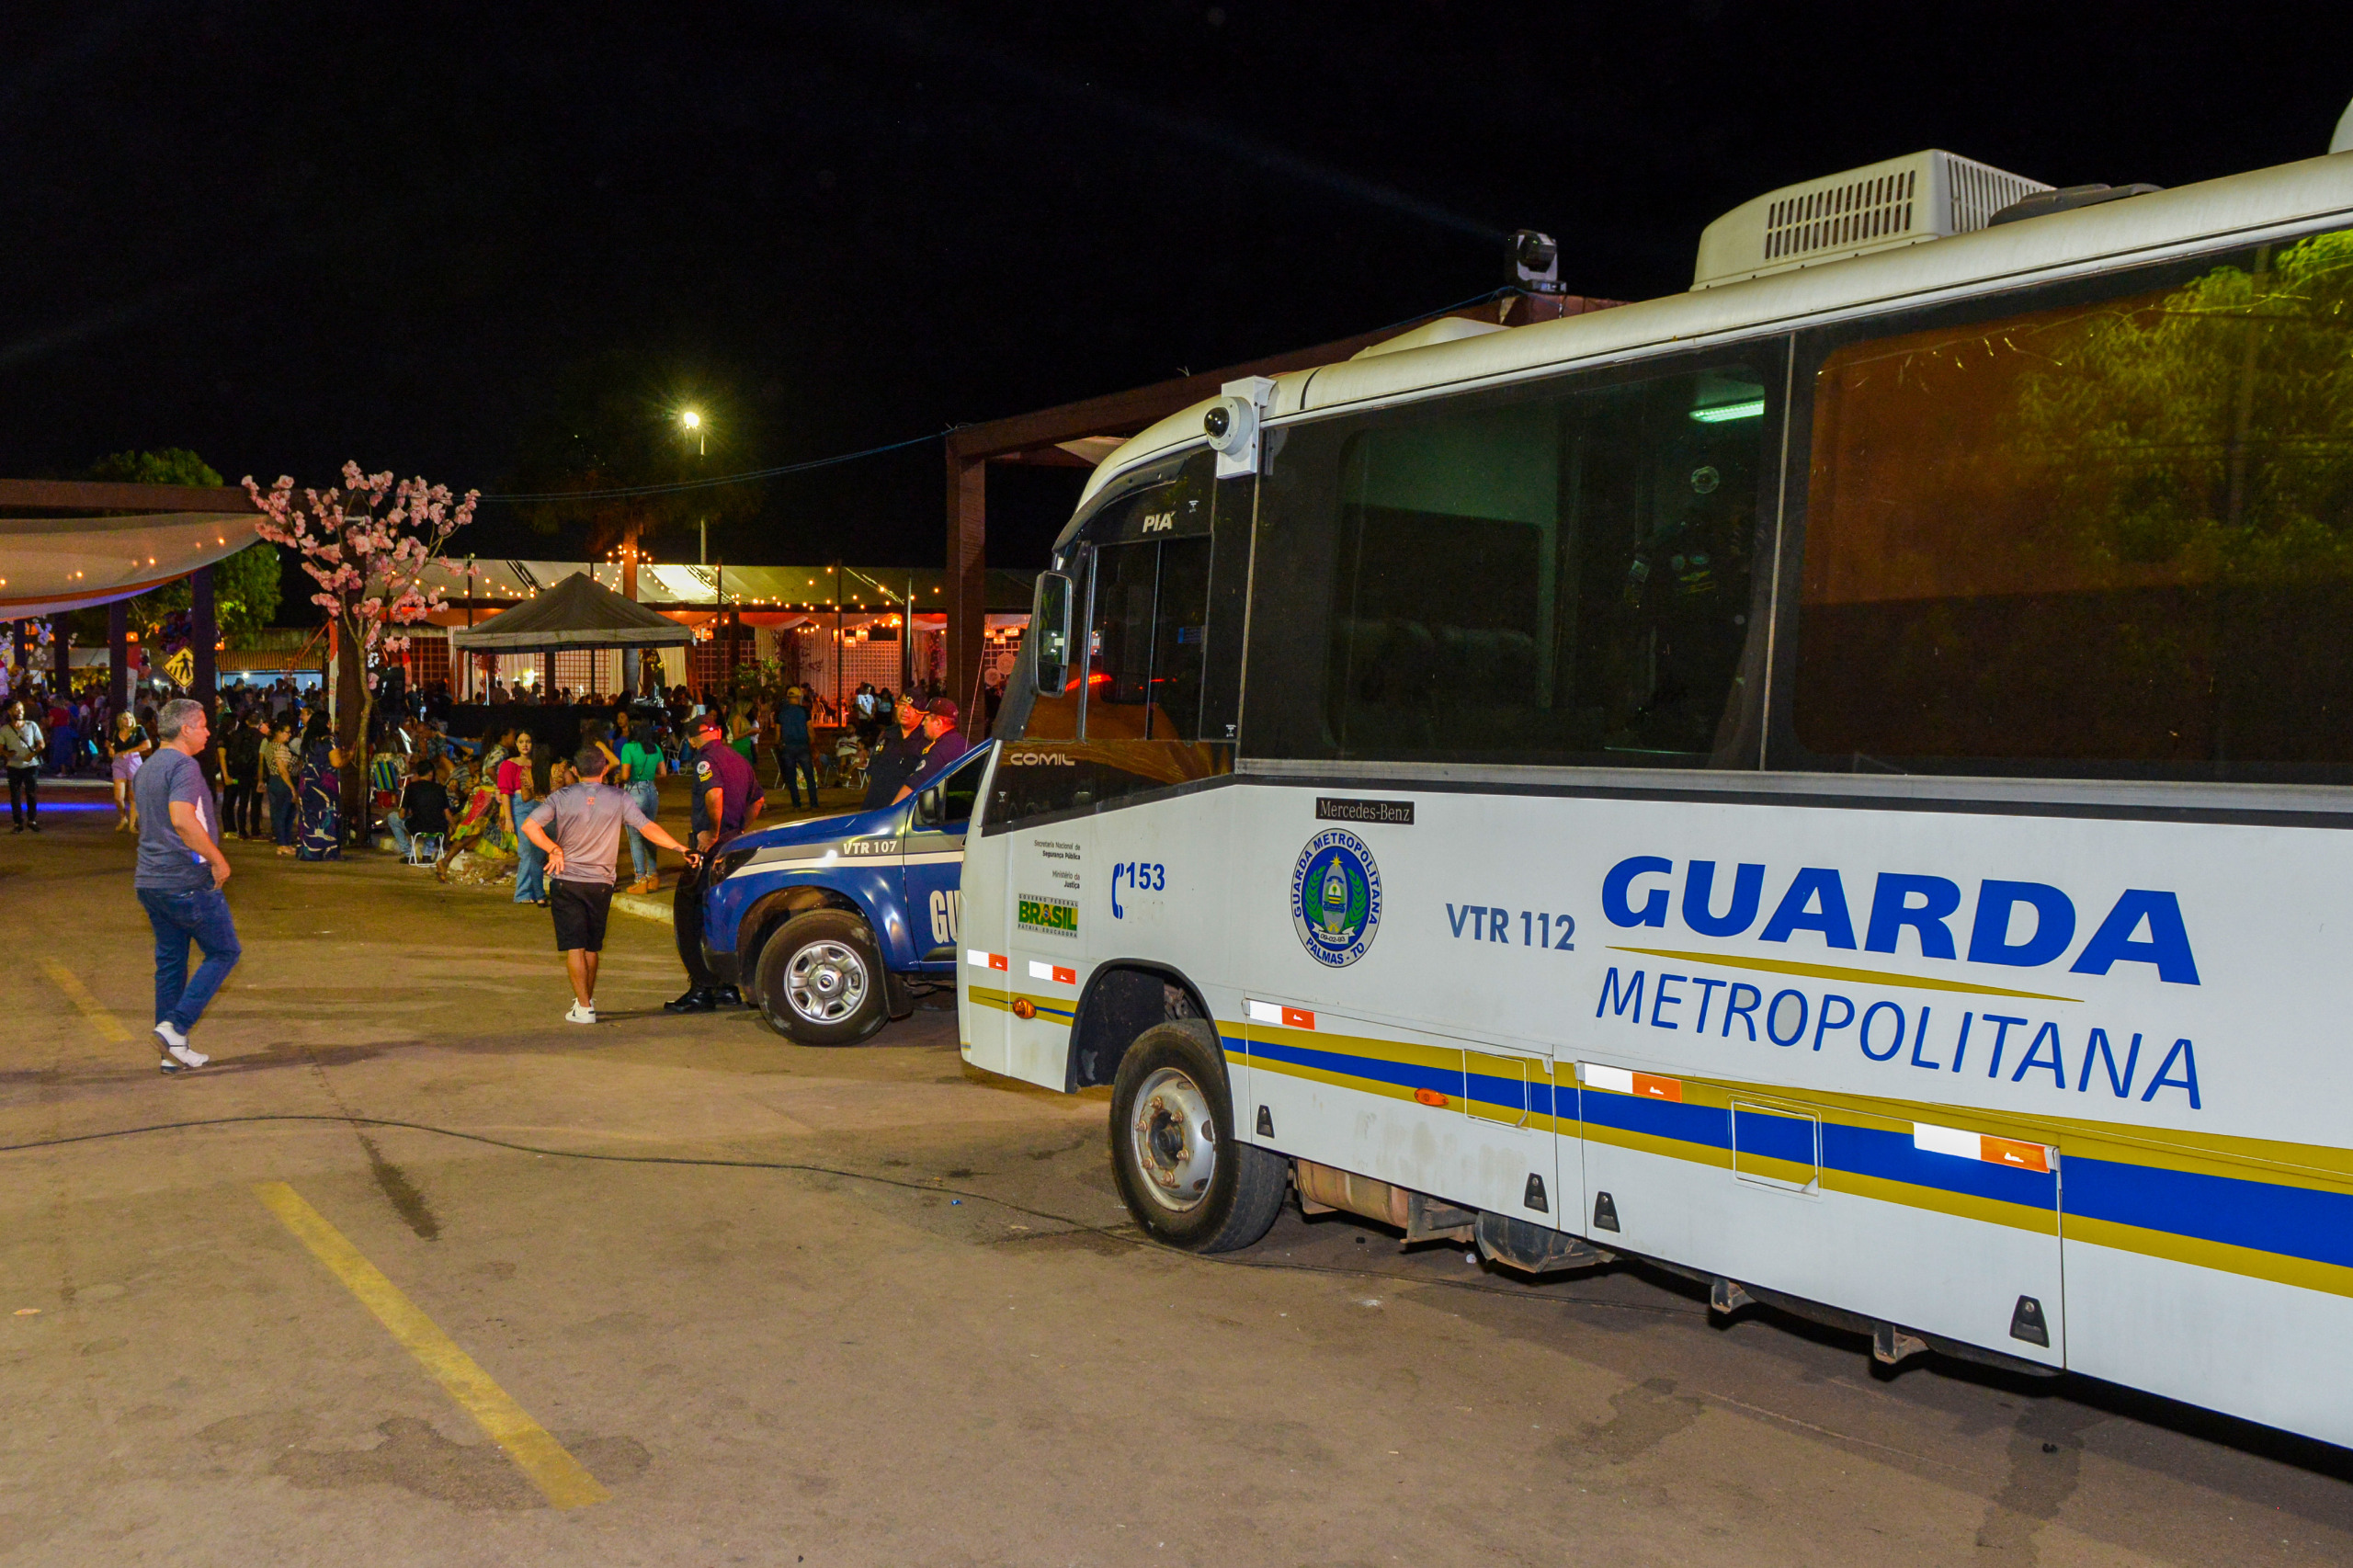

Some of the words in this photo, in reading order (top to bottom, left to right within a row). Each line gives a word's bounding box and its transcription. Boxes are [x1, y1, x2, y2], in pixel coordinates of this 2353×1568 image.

[1010, 753, 1075, 767] COMIL
[1320, 800, 1410, 822] Mercedes-Benz
[843, 841, 870, 855] VTR
[874, 840, 897, 854] 107
[1034, 840, 1055, 848] Secretaria
[1055, 841, 1074, 850] Nacional
[1042, 850, 1064, 858] Segurança
[1064, 852, 1081, 860] Pública
[1052, 870, 1074, 880] Ministério
[1126, 862, 1165, 891] 153
[1292, 850, 1313, 918] GUARDA
[1313, 833, 1381, 925] METROPOLITANA
[1064, 881, 1080, 889] Justiça
[1018, 893, 1047, 903] GOVERNO
[1051, 898, 1078, 907] FEDERAL
[1018, 900, 1077, 931] BRASIL
[1602, 855, 2201, 986] GUARDA
[1042, 927, 1077, 937] EDUCADORA
[1446, 903, 1510, 943] VTR
[1519, 911, 1575, 951] 112
[1305, 936, 1344, 964] PALMAS
[1351, 941, 1365, 959] TO
[1596, 967, 2202, 1110] METROPOLITANA
